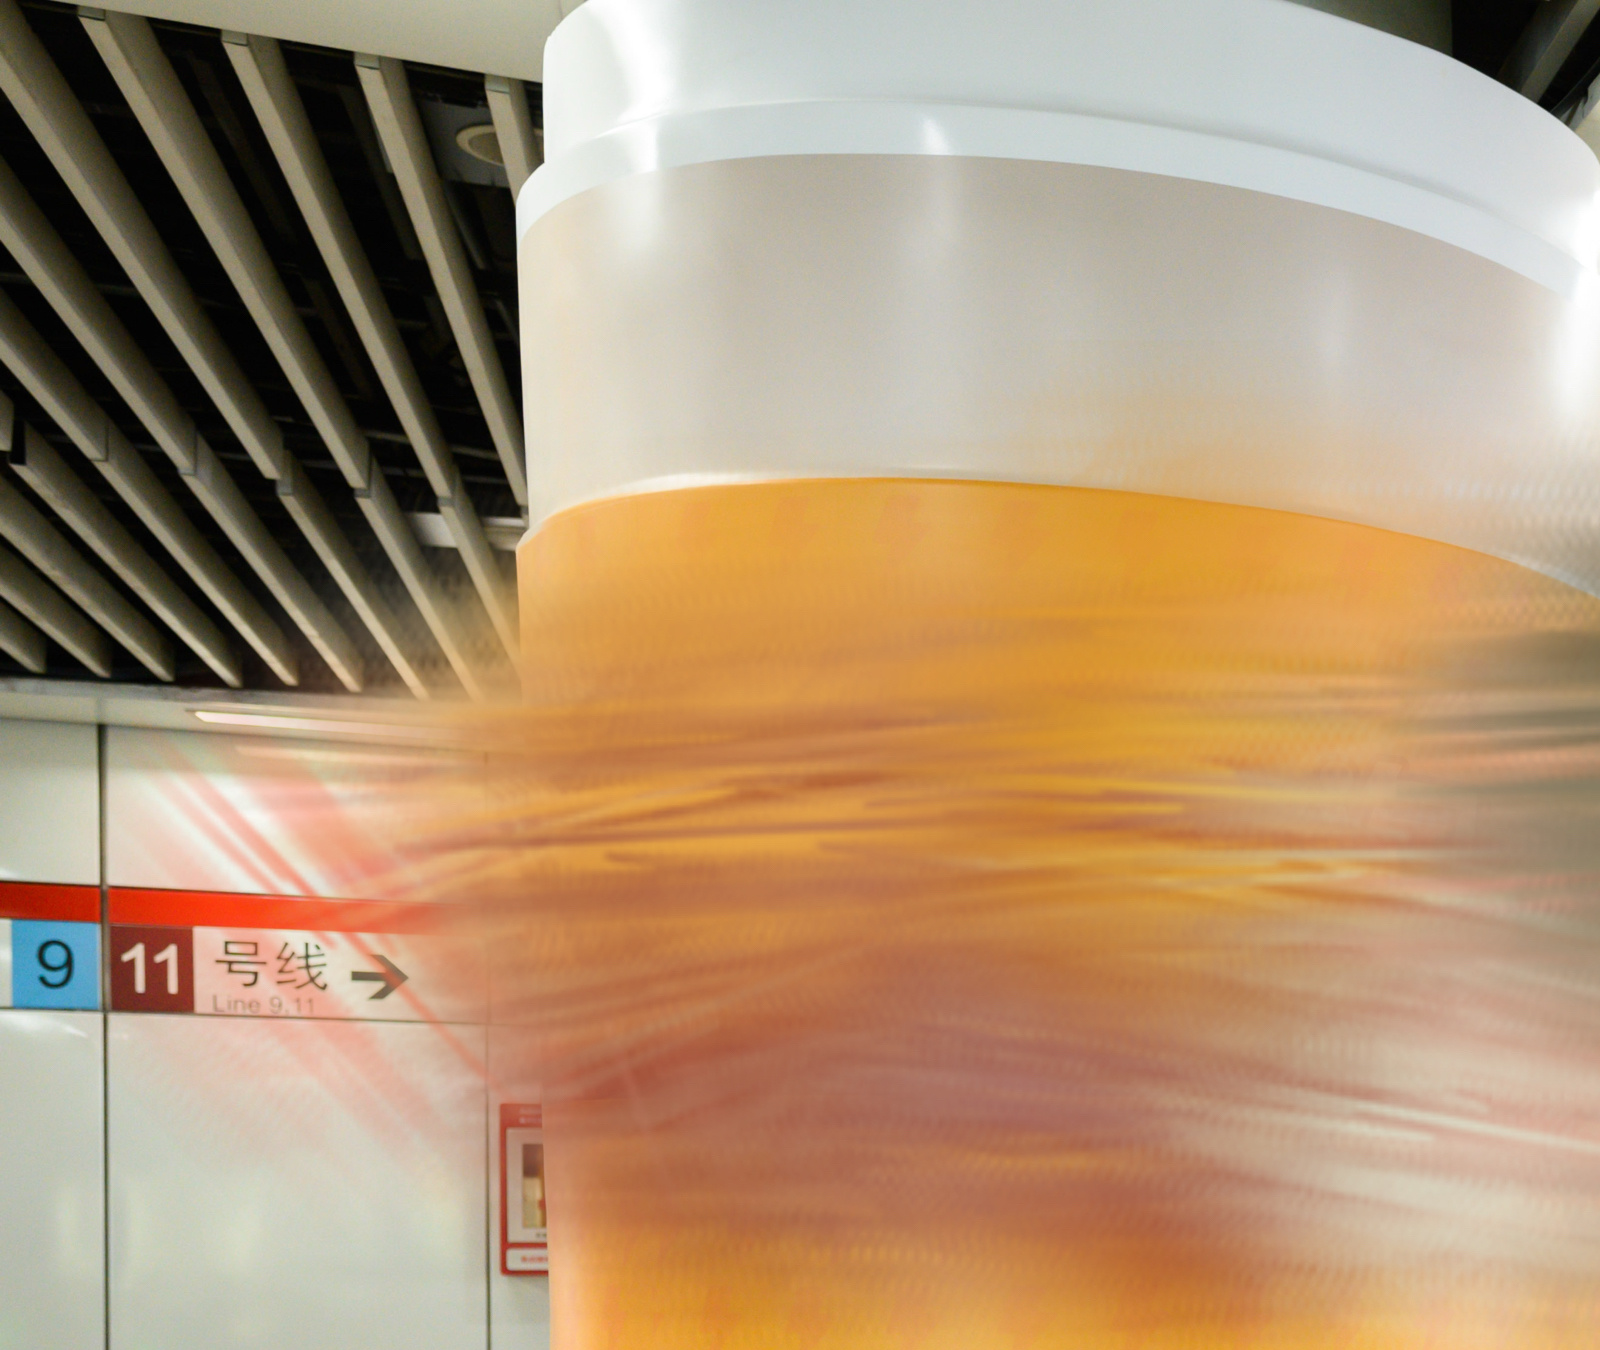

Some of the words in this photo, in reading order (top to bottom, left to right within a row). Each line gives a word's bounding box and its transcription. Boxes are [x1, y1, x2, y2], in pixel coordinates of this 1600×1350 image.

[37, 941, 74, 989] 9
[121, 942, 179, 995] 11
[214, 940, 328, 992] 号线
[212, 994, 261, 1014] Line
